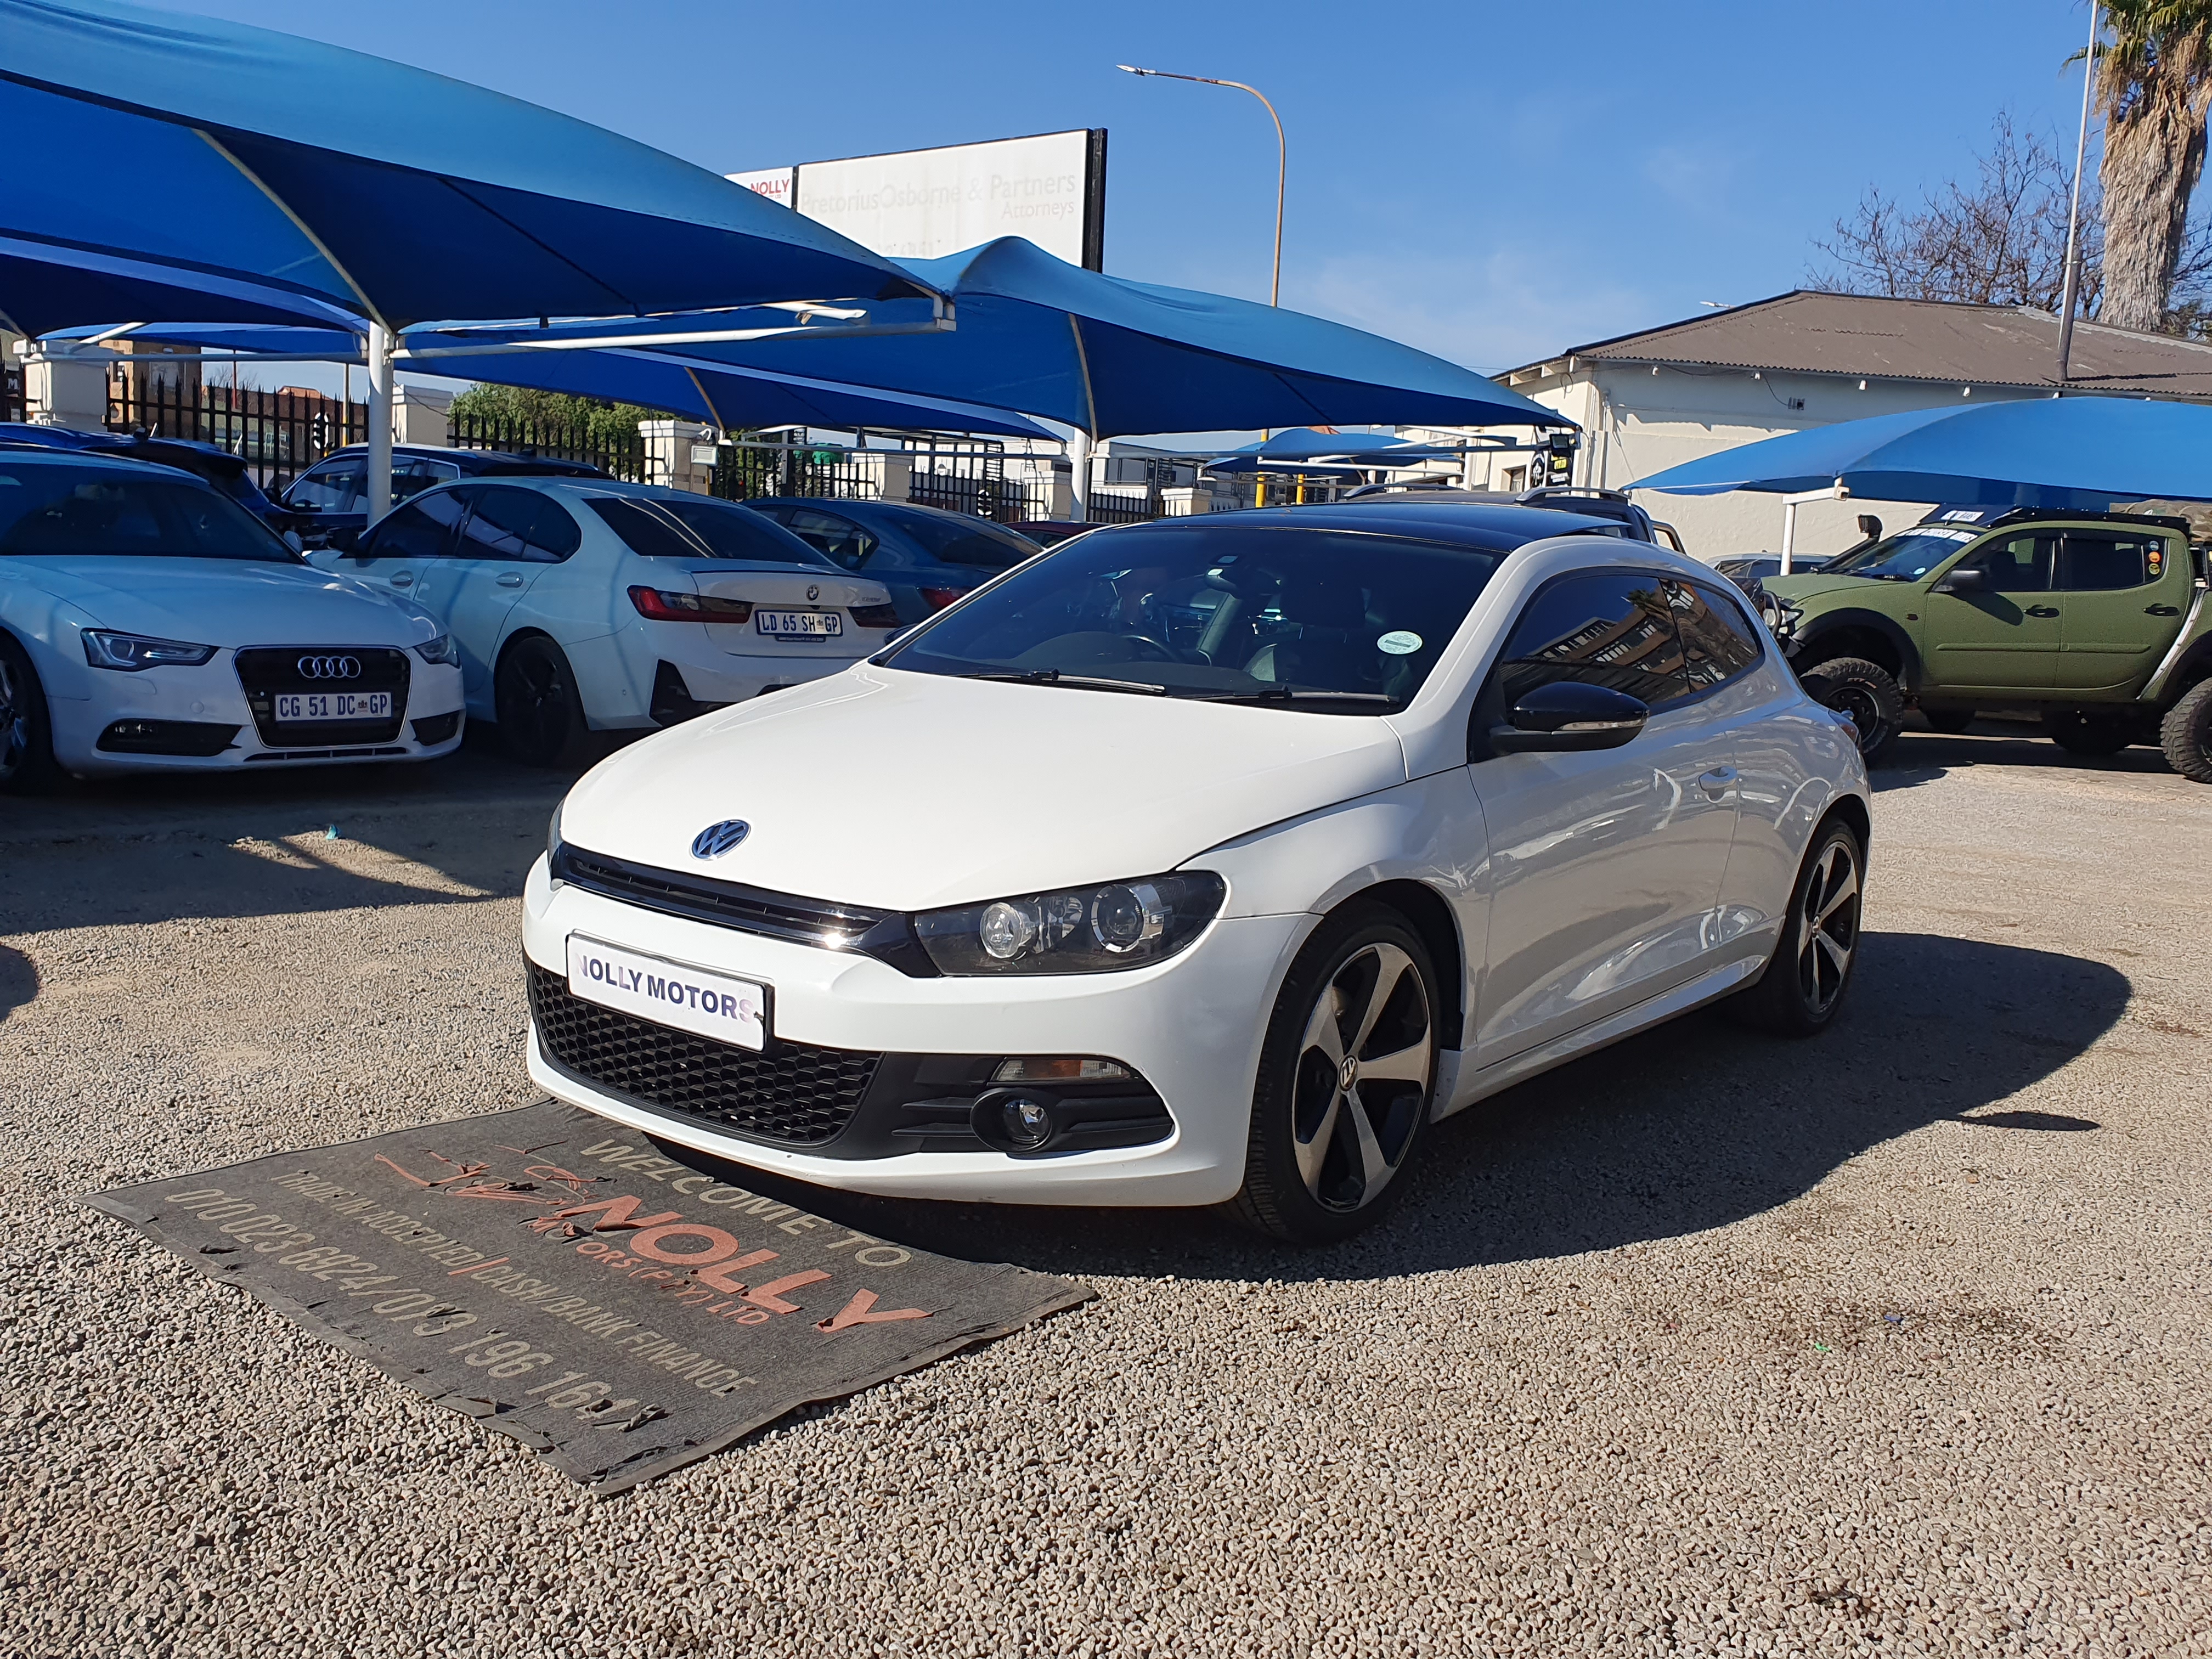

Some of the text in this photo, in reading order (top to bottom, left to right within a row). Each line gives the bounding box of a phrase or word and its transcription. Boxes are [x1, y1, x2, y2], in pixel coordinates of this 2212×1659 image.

[751, 178, 790, 195] NOLLY
[967, 177, 983, 202] &
[990, 173, 1076, 200] Partners
[1001, 200, 1075, 221] Attorneys
[761, 614, 838, 633] LD 65 SH GP
[279, 694, 388, 718] CG 51 DC GP
[574, 952, 755, 1023] NOLLY MOTORS
[580, 1138, 913, 1266] WELCOME TO
[552, 1194, 933, 1333] NOLLY
[164, 1188, 257, 1222] 010
[219, 1214, 316, 1254] 023
[447, 1328, 554, 1378] 196
[270, 1169, 358, 1203] TRADE
[330, 1197, 381, 1216] IN
[613, 1330, 760, 1400] FINANCE
[706, 1301, 770, 1325] LTD
